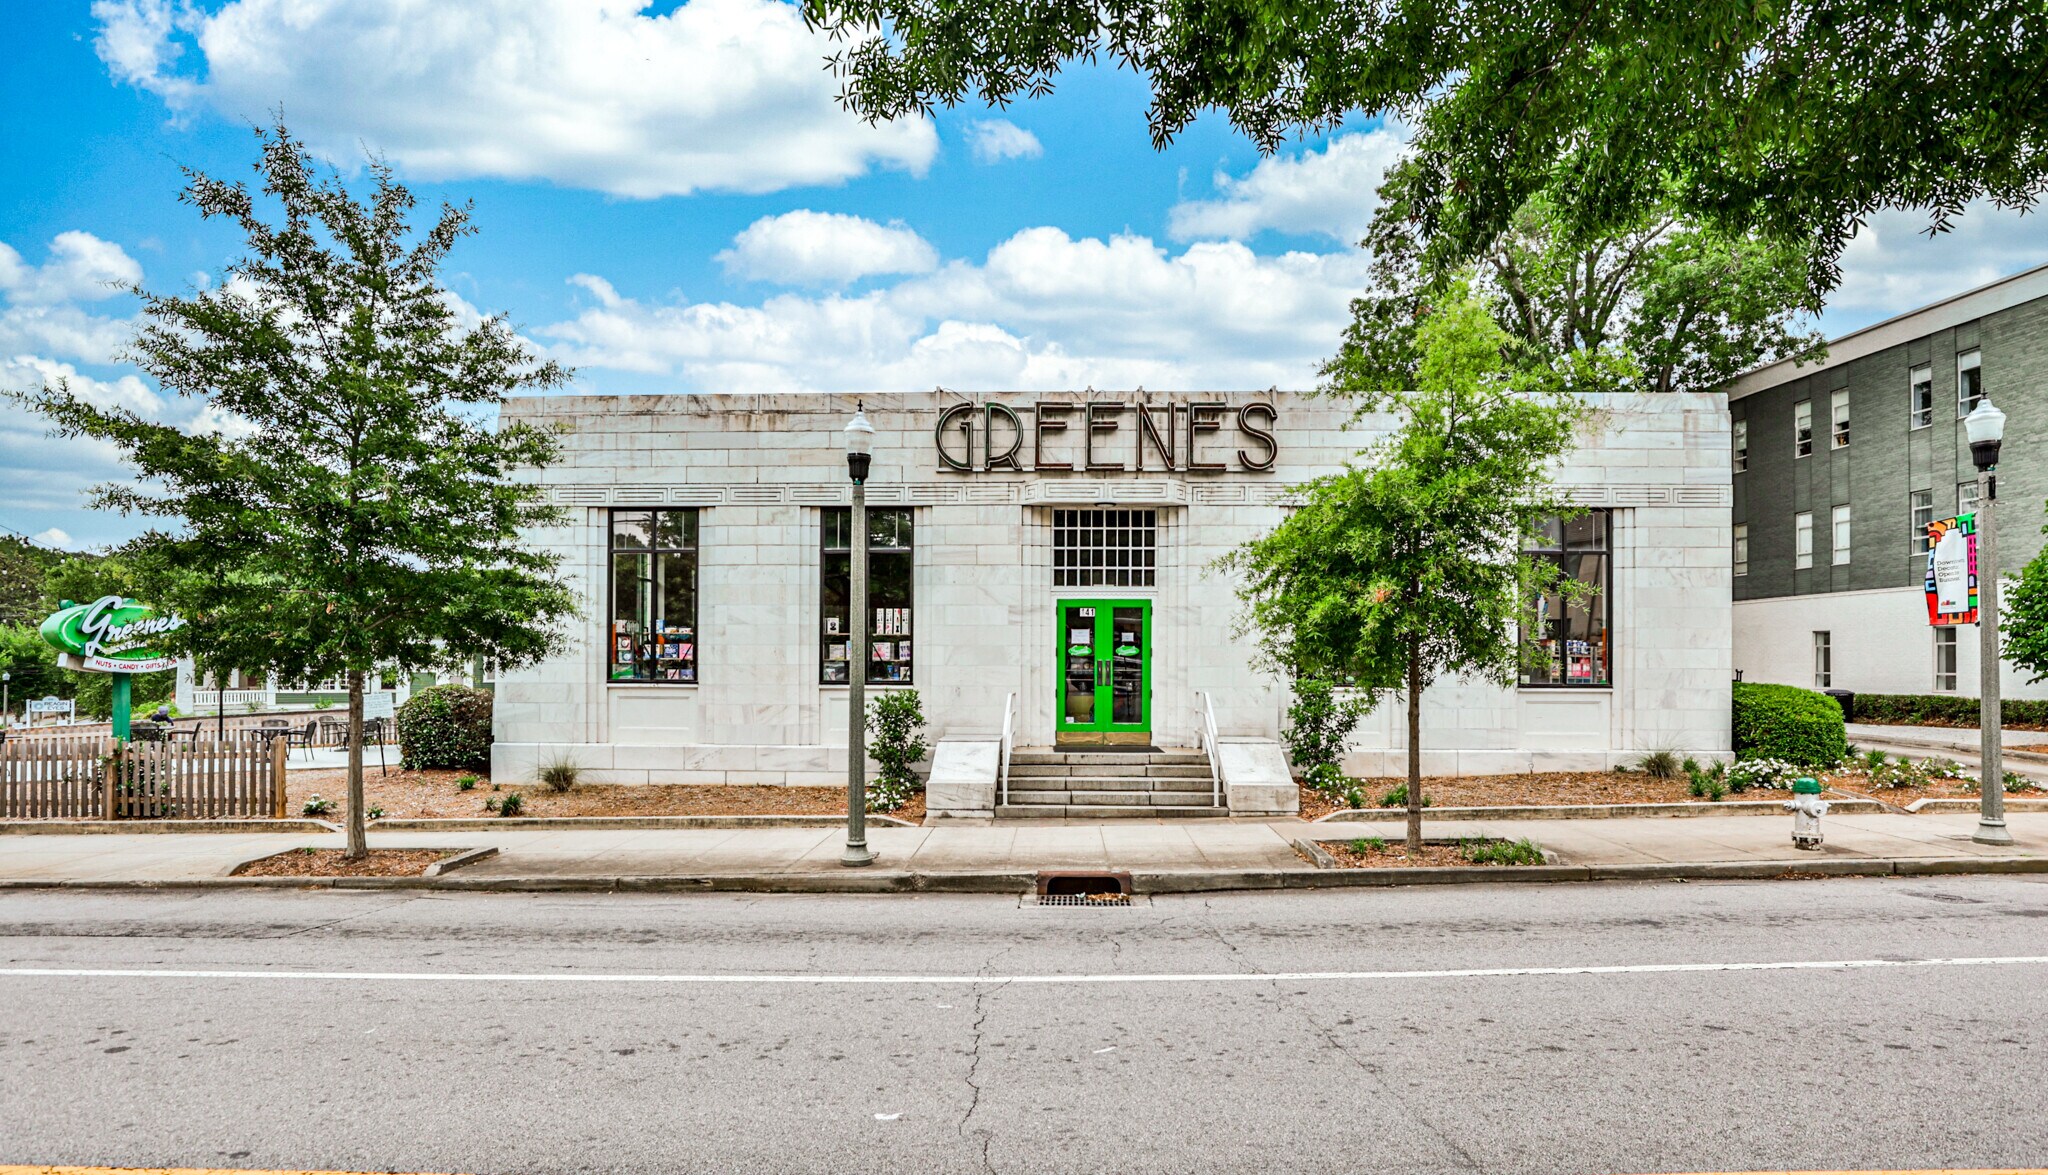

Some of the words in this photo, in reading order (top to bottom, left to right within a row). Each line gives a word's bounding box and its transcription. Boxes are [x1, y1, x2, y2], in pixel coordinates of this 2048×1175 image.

[935, 401, 1278, 471] GREENES
[82, 595, 188, 657] Greenes
[1081, 608, 1094, 616] 141
[95, 660, 112, 668] NUTS
